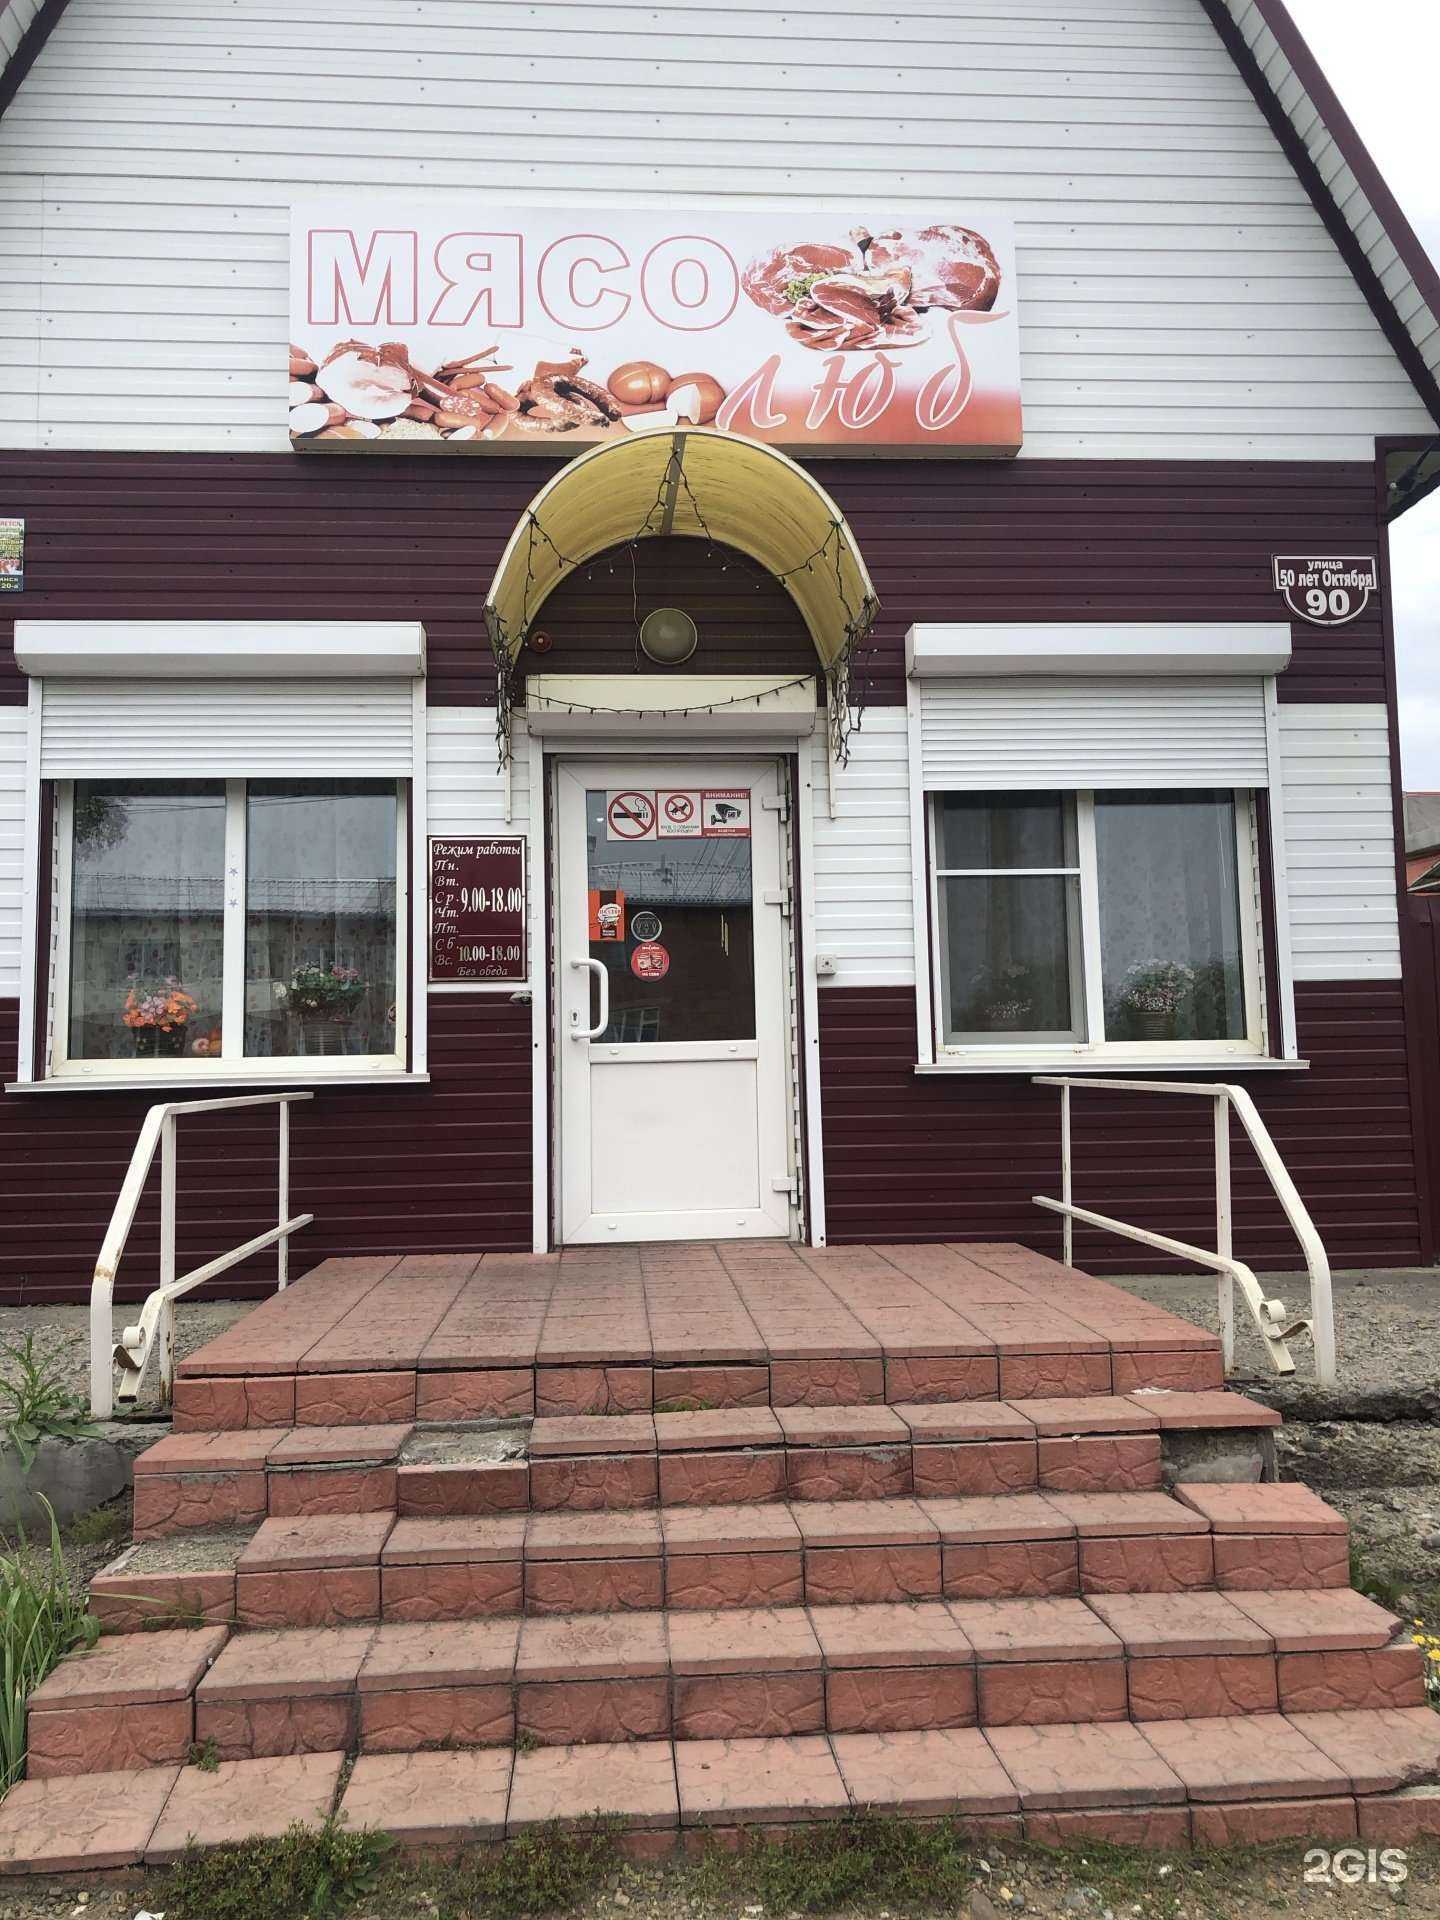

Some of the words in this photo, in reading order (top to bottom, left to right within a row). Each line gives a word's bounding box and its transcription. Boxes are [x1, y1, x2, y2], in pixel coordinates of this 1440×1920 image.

[307, 229, 740, 332] МЯСО
[1307, 560, 1344, 571] улица
[1280, 569, 1295, 587] 50
[1298, 572, 1320, 587] лет
[1322, 569, 1373, 590] Октября
[1305, 589, 1350, 616] 90
[433, 843, 474, 857] Режим
[475, 842, 521, 858] работы
[434, 860, 459, 871] Пн.
[434, 875, 460, 887] Вт.
[460, 887, 521, 913] 9.00-18.00
[434, 906, 460, 918] Чт.
[434, 922, 460, 934] Пт.
[459, 945, 520, 961] 10.00-18.00
[457, 966, 476, 976] Без
[480, 965, 508, 976] обеда
